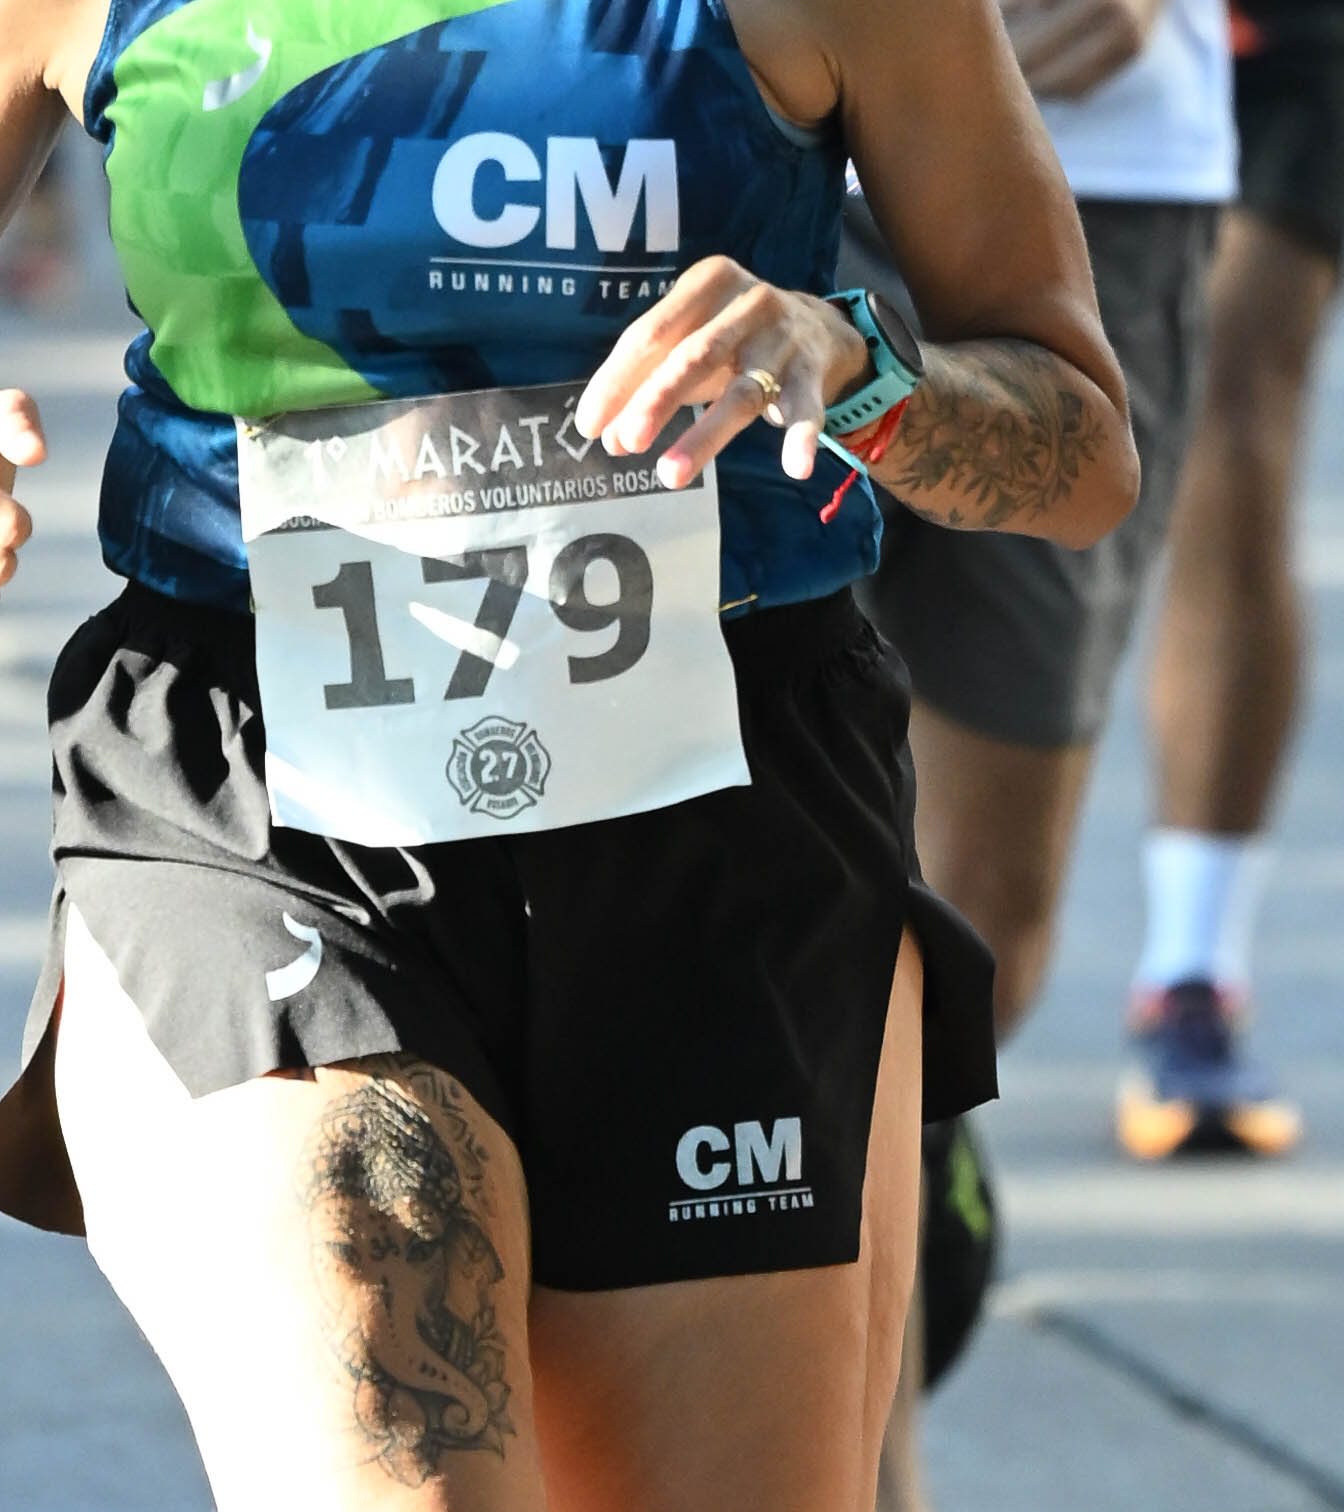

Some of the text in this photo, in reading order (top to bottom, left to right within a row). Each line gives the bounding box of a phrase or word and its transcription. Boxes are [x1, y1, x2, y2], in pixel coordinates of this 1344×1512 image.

[432, 131, 680, 252] CM
[429, 271, 576, 297] RUNNING
[479, 476, 608, 510] VOLUNTARIOS
[312, 532, 653, 710] 179
[479, 749, 518, 784] 27
[675, 1117, 802, 1190] CM
[669, 1191, 814, 1222] RUNNING TEAM
